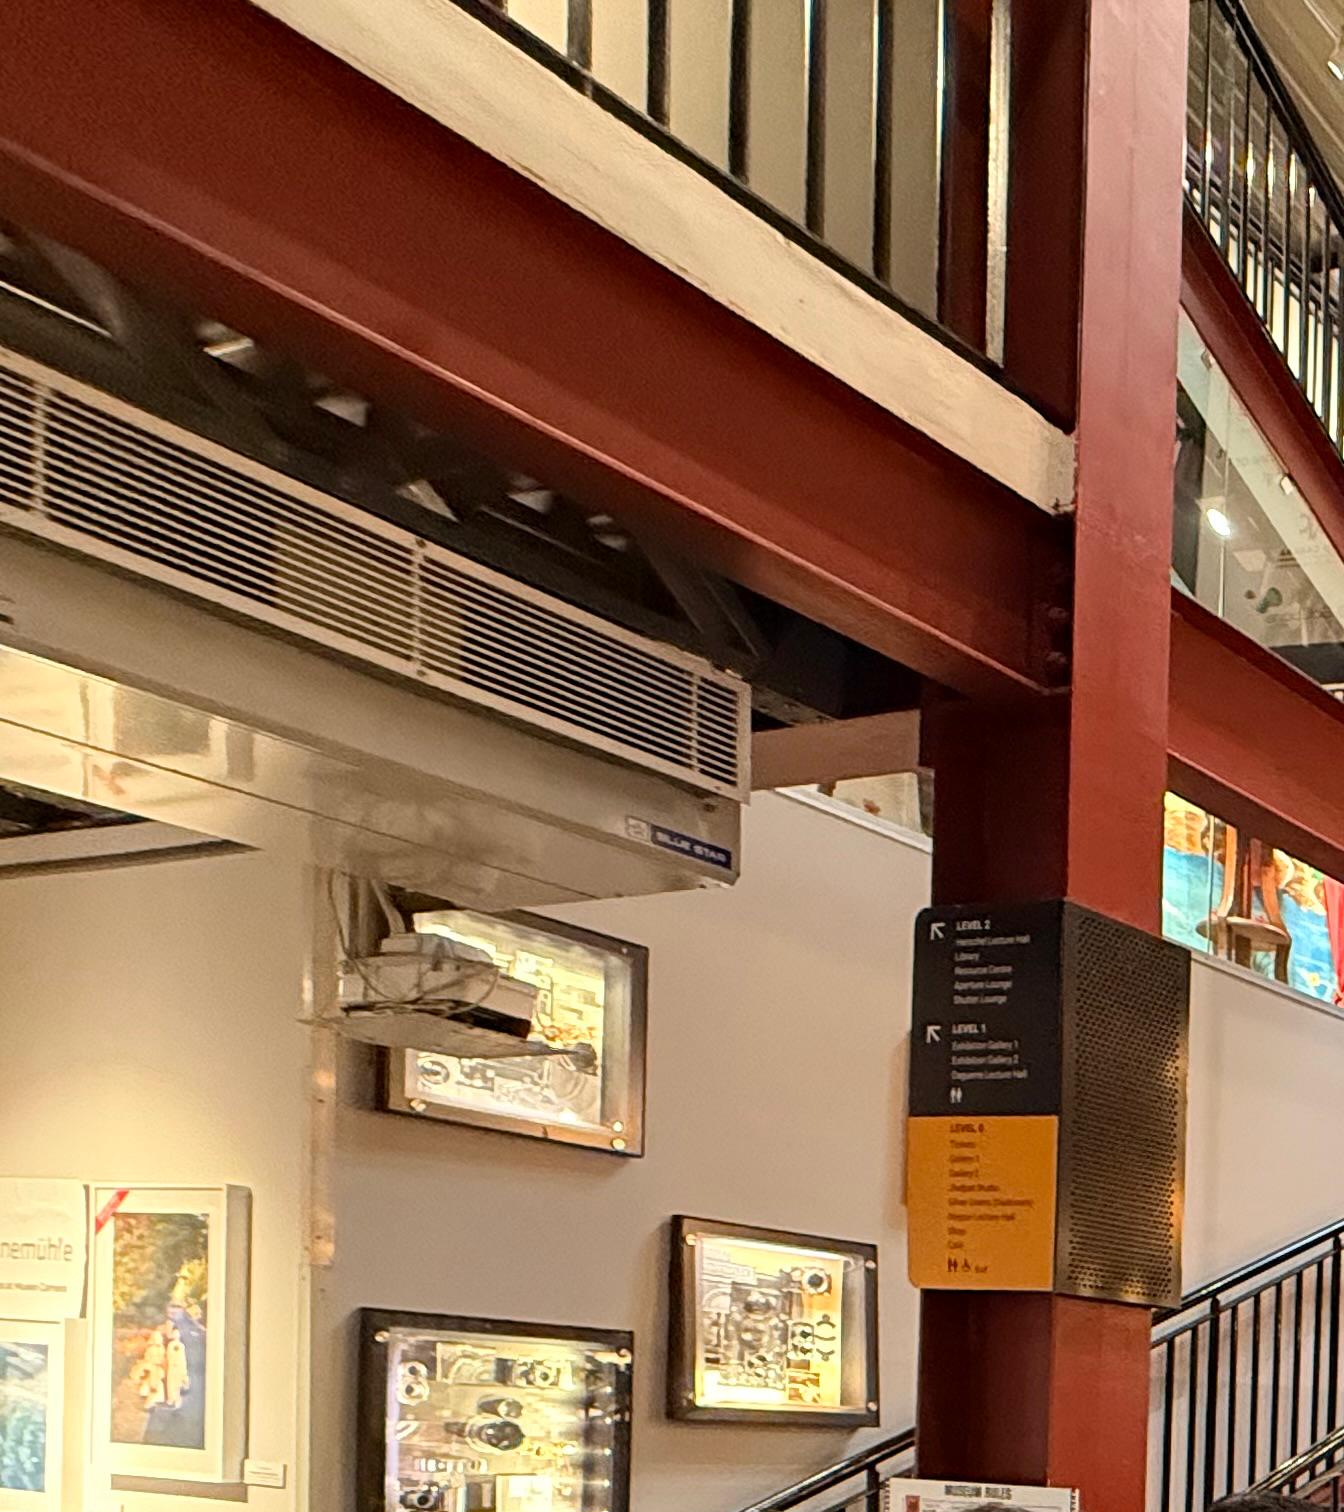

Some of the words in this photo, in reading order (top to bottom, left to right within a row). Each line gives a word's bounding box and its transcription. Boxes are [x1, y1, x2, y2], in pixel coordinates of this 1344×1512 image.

[693, 844, 727, 863] STAR
[956, 921, 983, 931] LEVEL
[984, 920, 991, 930] 2
[952, 1024, 979, 1034] LEVEL
